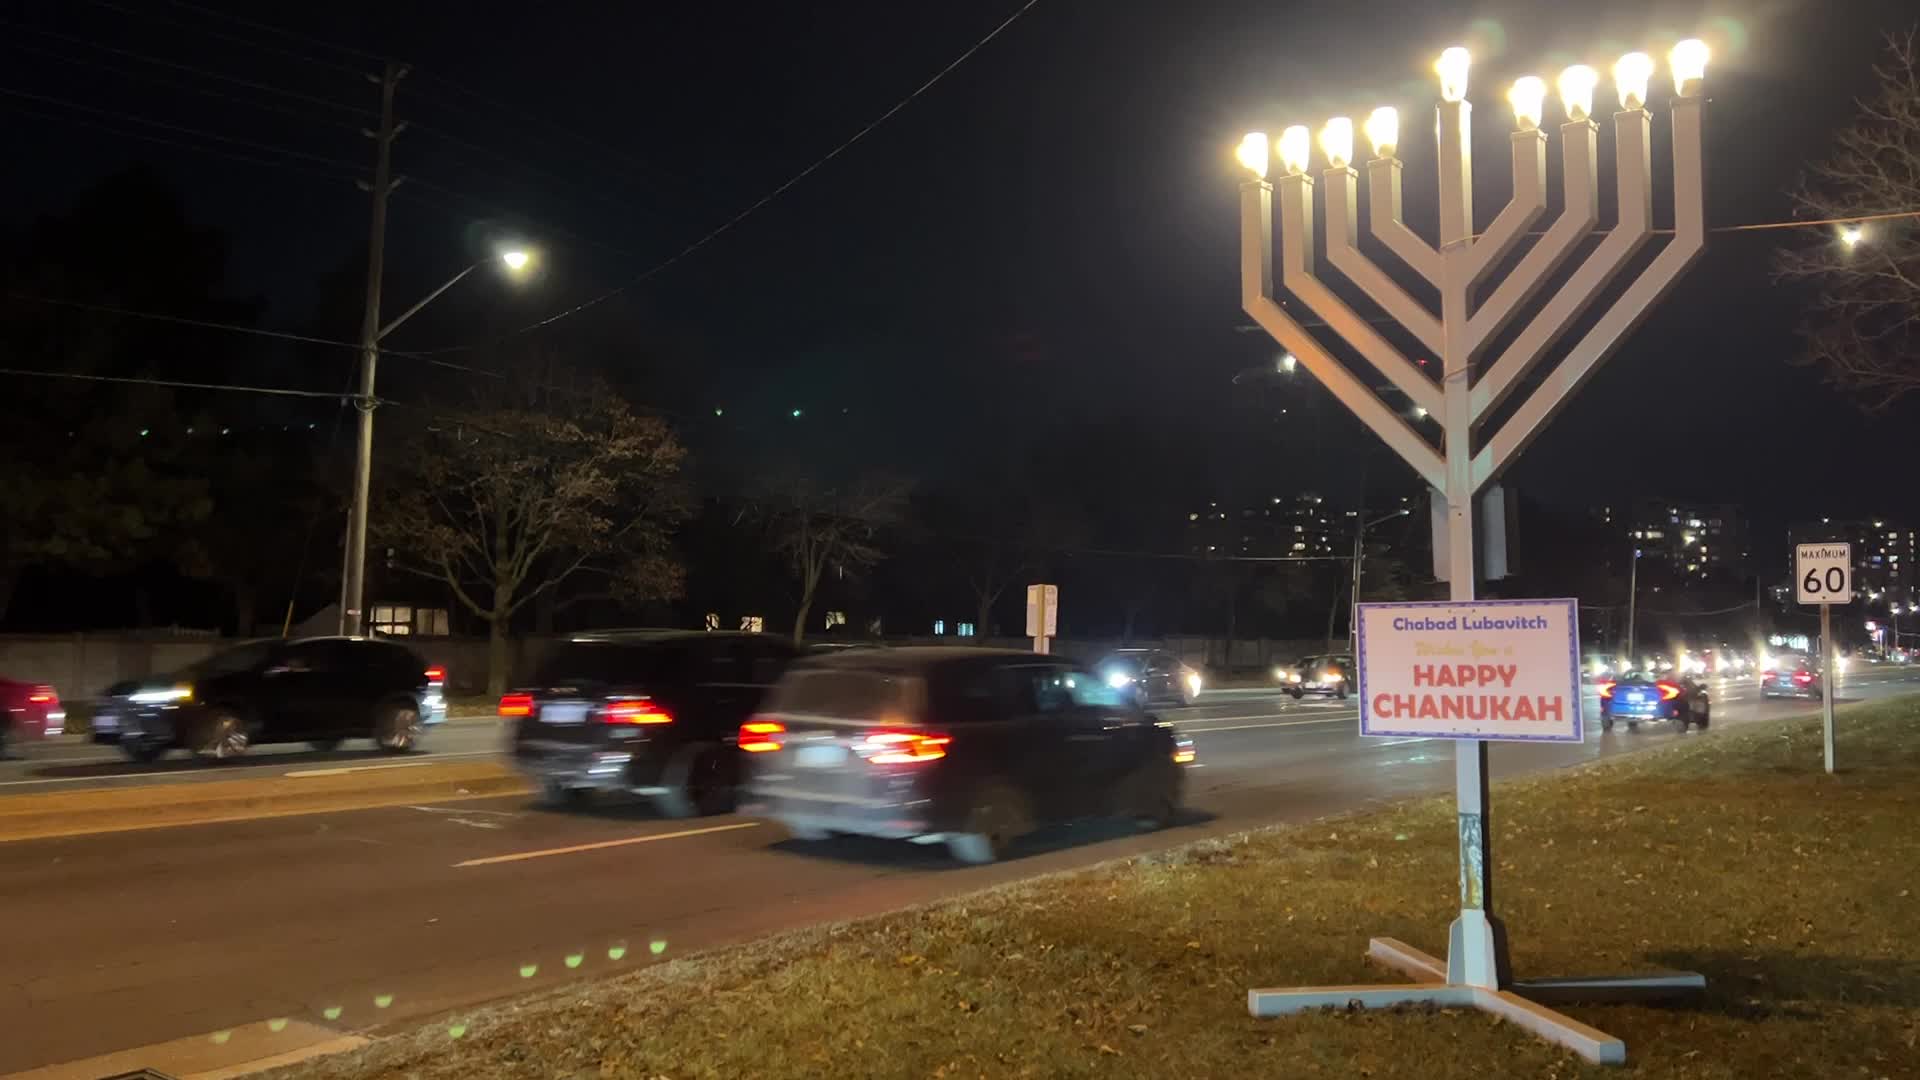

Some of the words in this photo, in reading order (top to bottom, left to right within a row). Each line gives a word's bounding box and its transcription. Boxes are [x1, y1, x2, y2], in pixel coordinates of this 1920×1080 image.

[1801, 549, 1846, 559] MAXIMUM
[1803, 567, 1845, 593] 60
[1393, 616, 1457, 631] Chabad
[1463, 615, 1548, 631] Lubavitch
[1413, 664, 1517, 688] HAPPY
[1373, 693, 1563, 721] CHANUKAH
